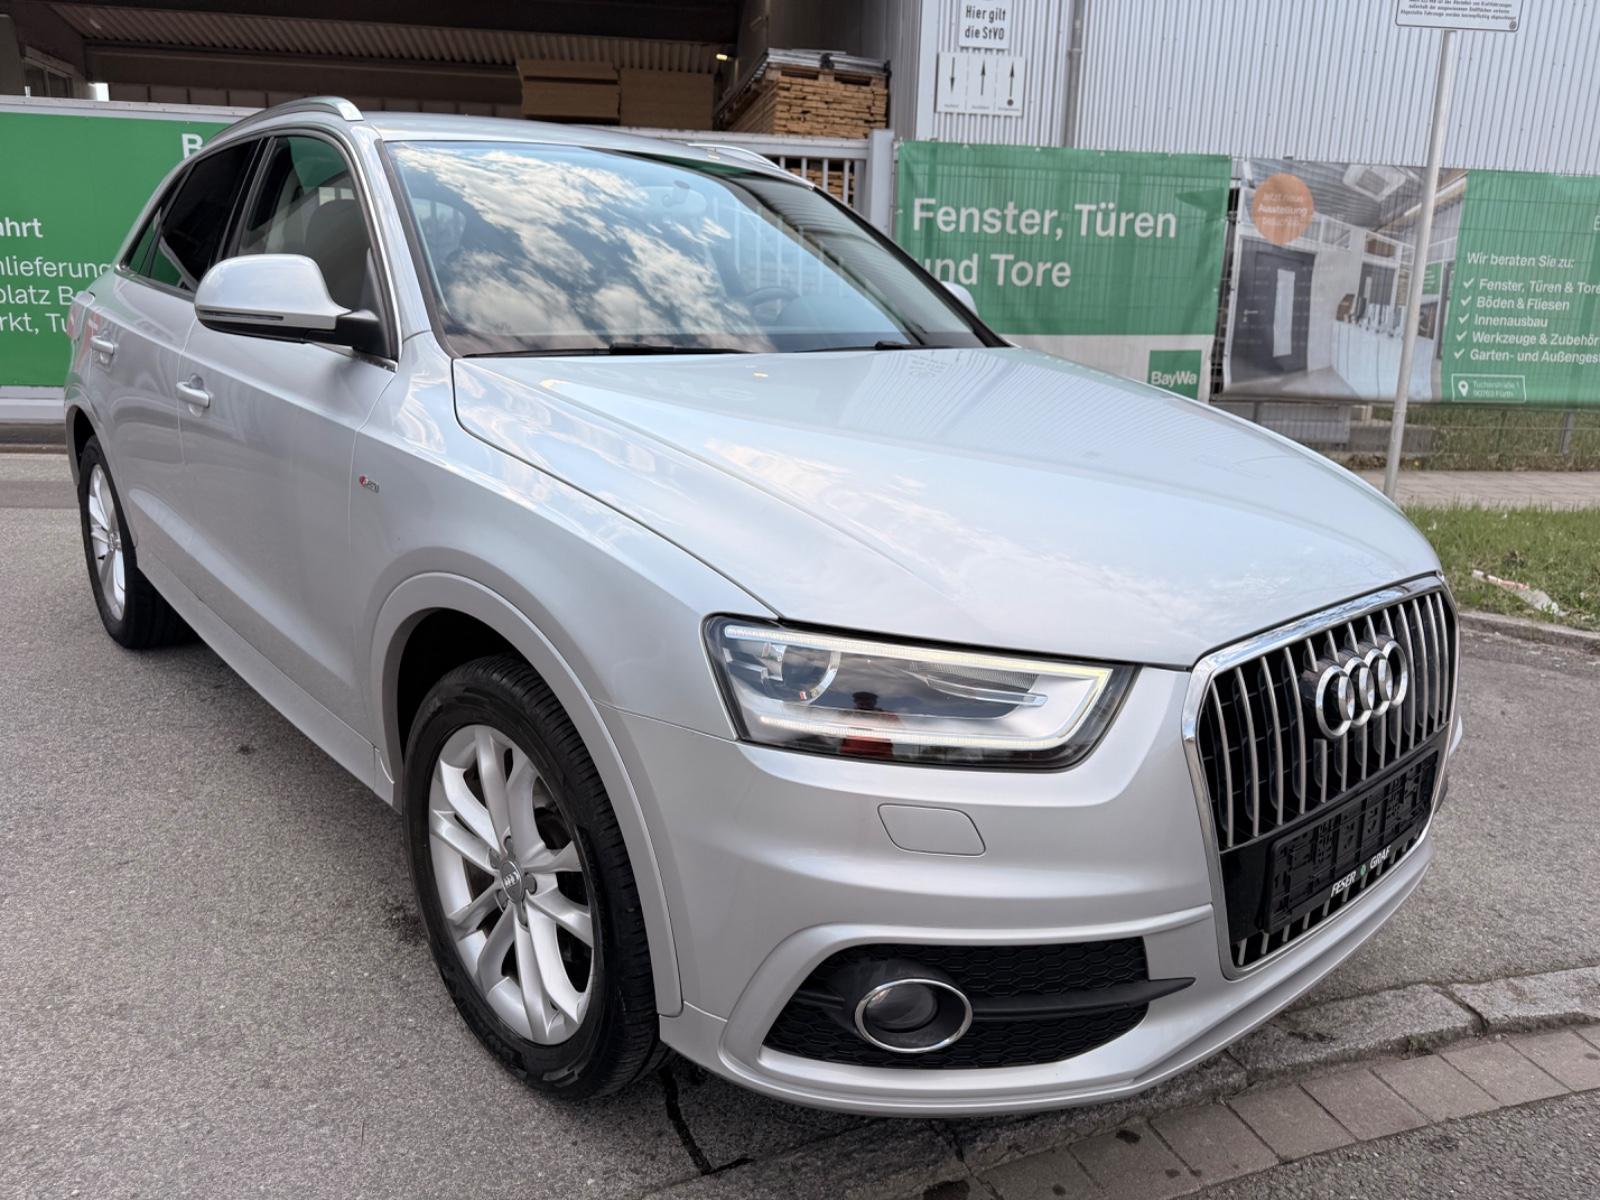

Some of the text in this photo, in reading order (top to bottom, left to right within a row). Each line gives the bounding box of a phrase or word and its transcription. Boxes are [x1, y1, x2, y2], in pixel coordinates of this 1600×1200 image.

[965, 4, 1006, 24] Hier gilt
[964, 25, 1005, 41] die StVO
[912, 197, 1177, 241] Fenster, Türen
[1467, 252, 1575, 269] Wir beraten Sie zu:
[990, 253, 1072, 288] Tore
[1479, 278, 1526, 293] Fenster,
[1529, 279, 1561, 293] Türen
[1564, 281, 1574, 293] &
[1476, 296, 1570, 311] Böden & Fliesen
[1474, 314, 1549, 328] Innenausbau
[1472, 331, 1537, 347] Werkzeuge
[1539, 333, 1548, 345] &
[1470, 348, 1514, 362] Garten-
[1517, 350, 1538, 362] und
[1151, 370, 1198, 388] BayWa
[1369, 844, 1392, 869] GRAF
